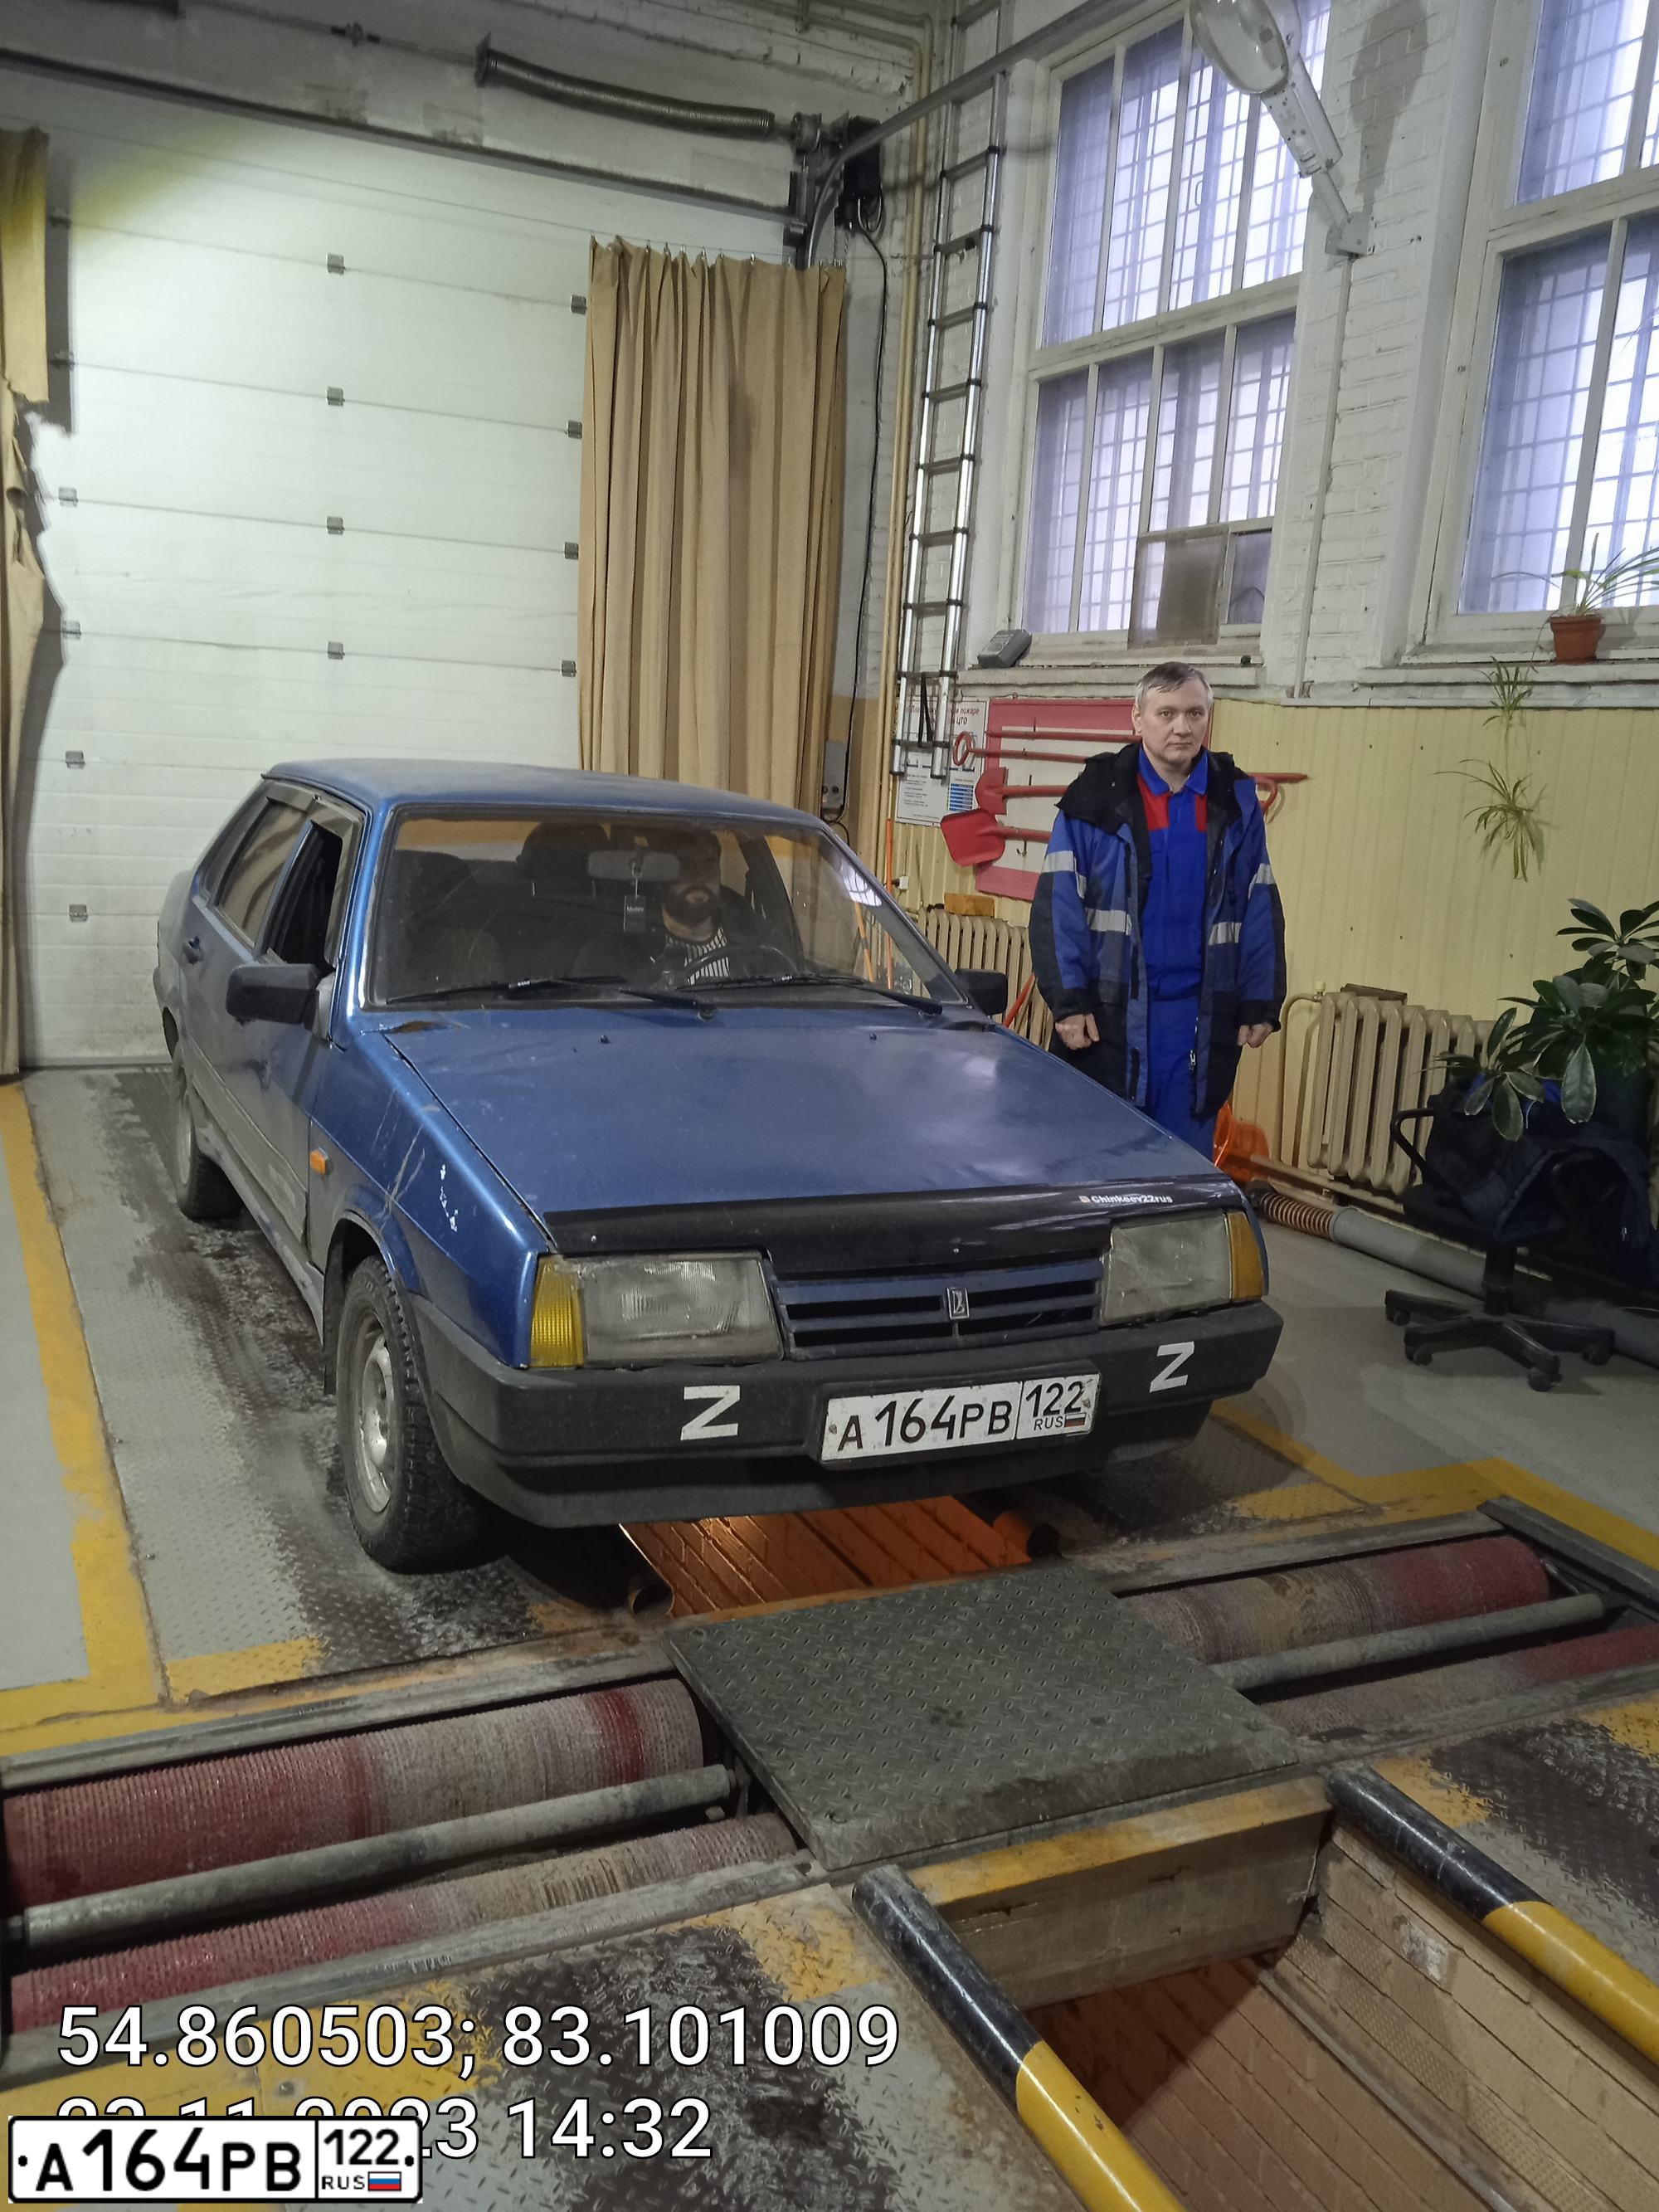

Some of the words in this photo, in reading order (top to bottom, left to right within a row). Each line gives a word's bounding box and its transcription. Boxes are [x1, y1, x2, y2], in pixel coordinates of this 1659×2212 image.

[956, 716, 968, 726] ЦТО
[1150, 1341, 1196, 1393] Z
[680, 1384, 741, 1442] Z
[1025, 1381, 1084, 1418] 122
[1033, 1416, 1063, 1431] RUS
